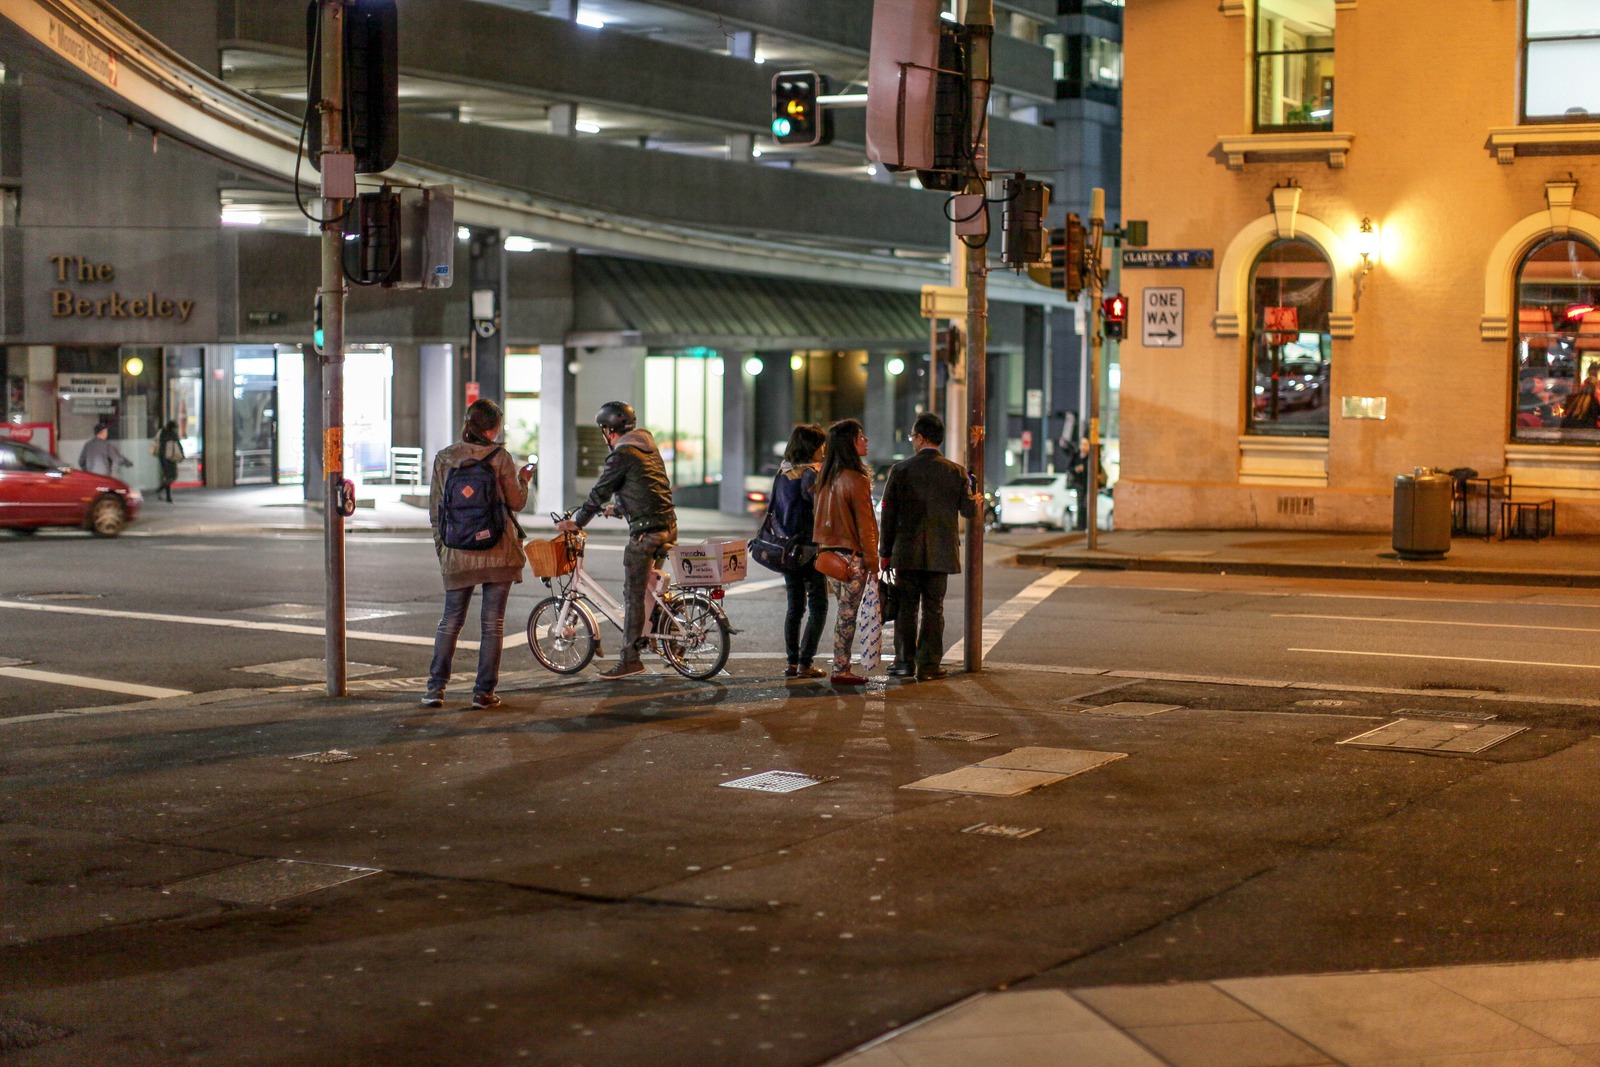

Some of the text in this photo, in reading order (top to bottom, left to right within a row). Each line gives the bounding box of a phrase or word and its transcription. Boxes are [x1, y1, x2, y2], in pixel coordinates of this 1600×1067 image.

[1123, 252, 1190, 263] CLARENCE ST
[51, 255, 115, 282] The
[1149, 292, 1178, 306] ONE
[51, 289, 194, 324] Berkeley
[1147, 311, 1180, 325] WAY
